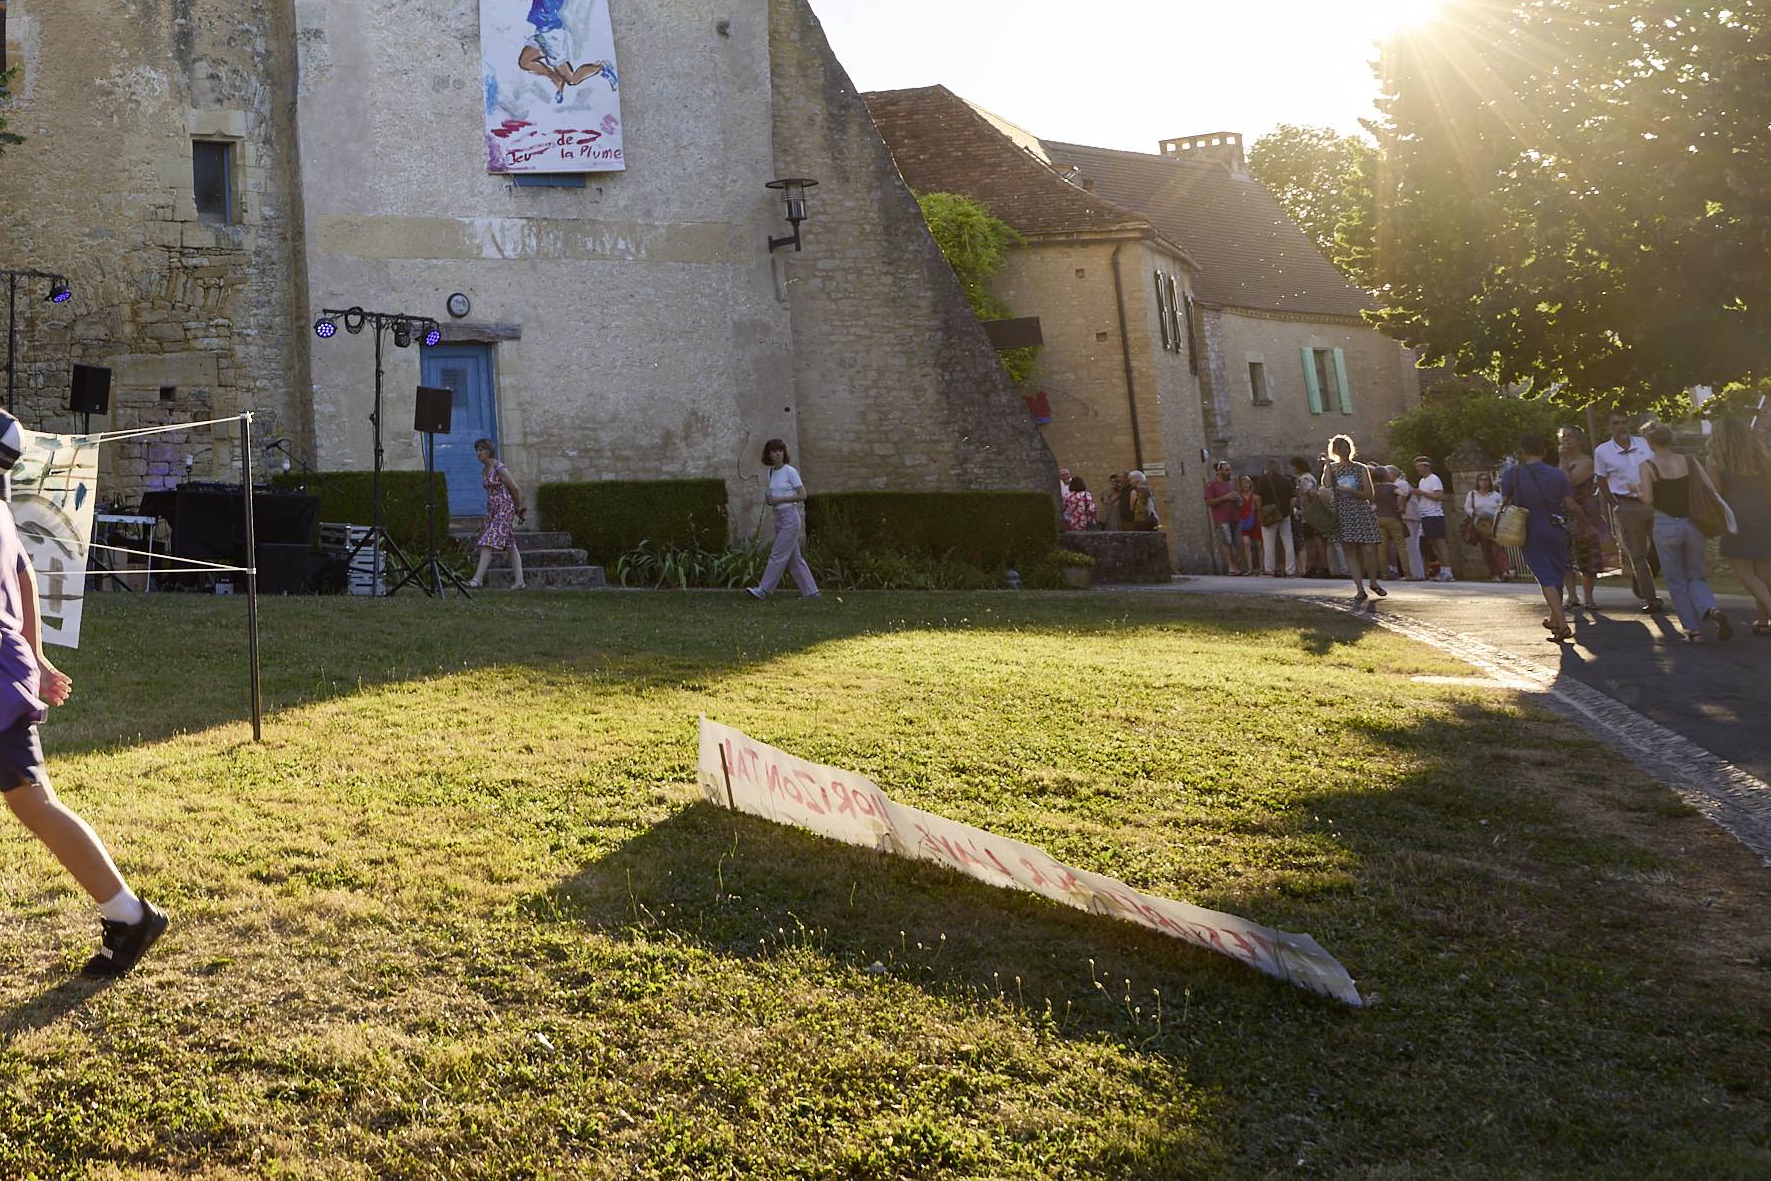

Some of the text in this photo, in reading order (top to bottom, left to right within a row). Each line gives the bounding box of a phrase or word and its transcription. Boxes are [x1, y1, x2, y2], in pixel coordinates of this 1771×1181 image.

[506, 129, 574, 165] Jeu de
[561, 145, 622, 161] la Plume
